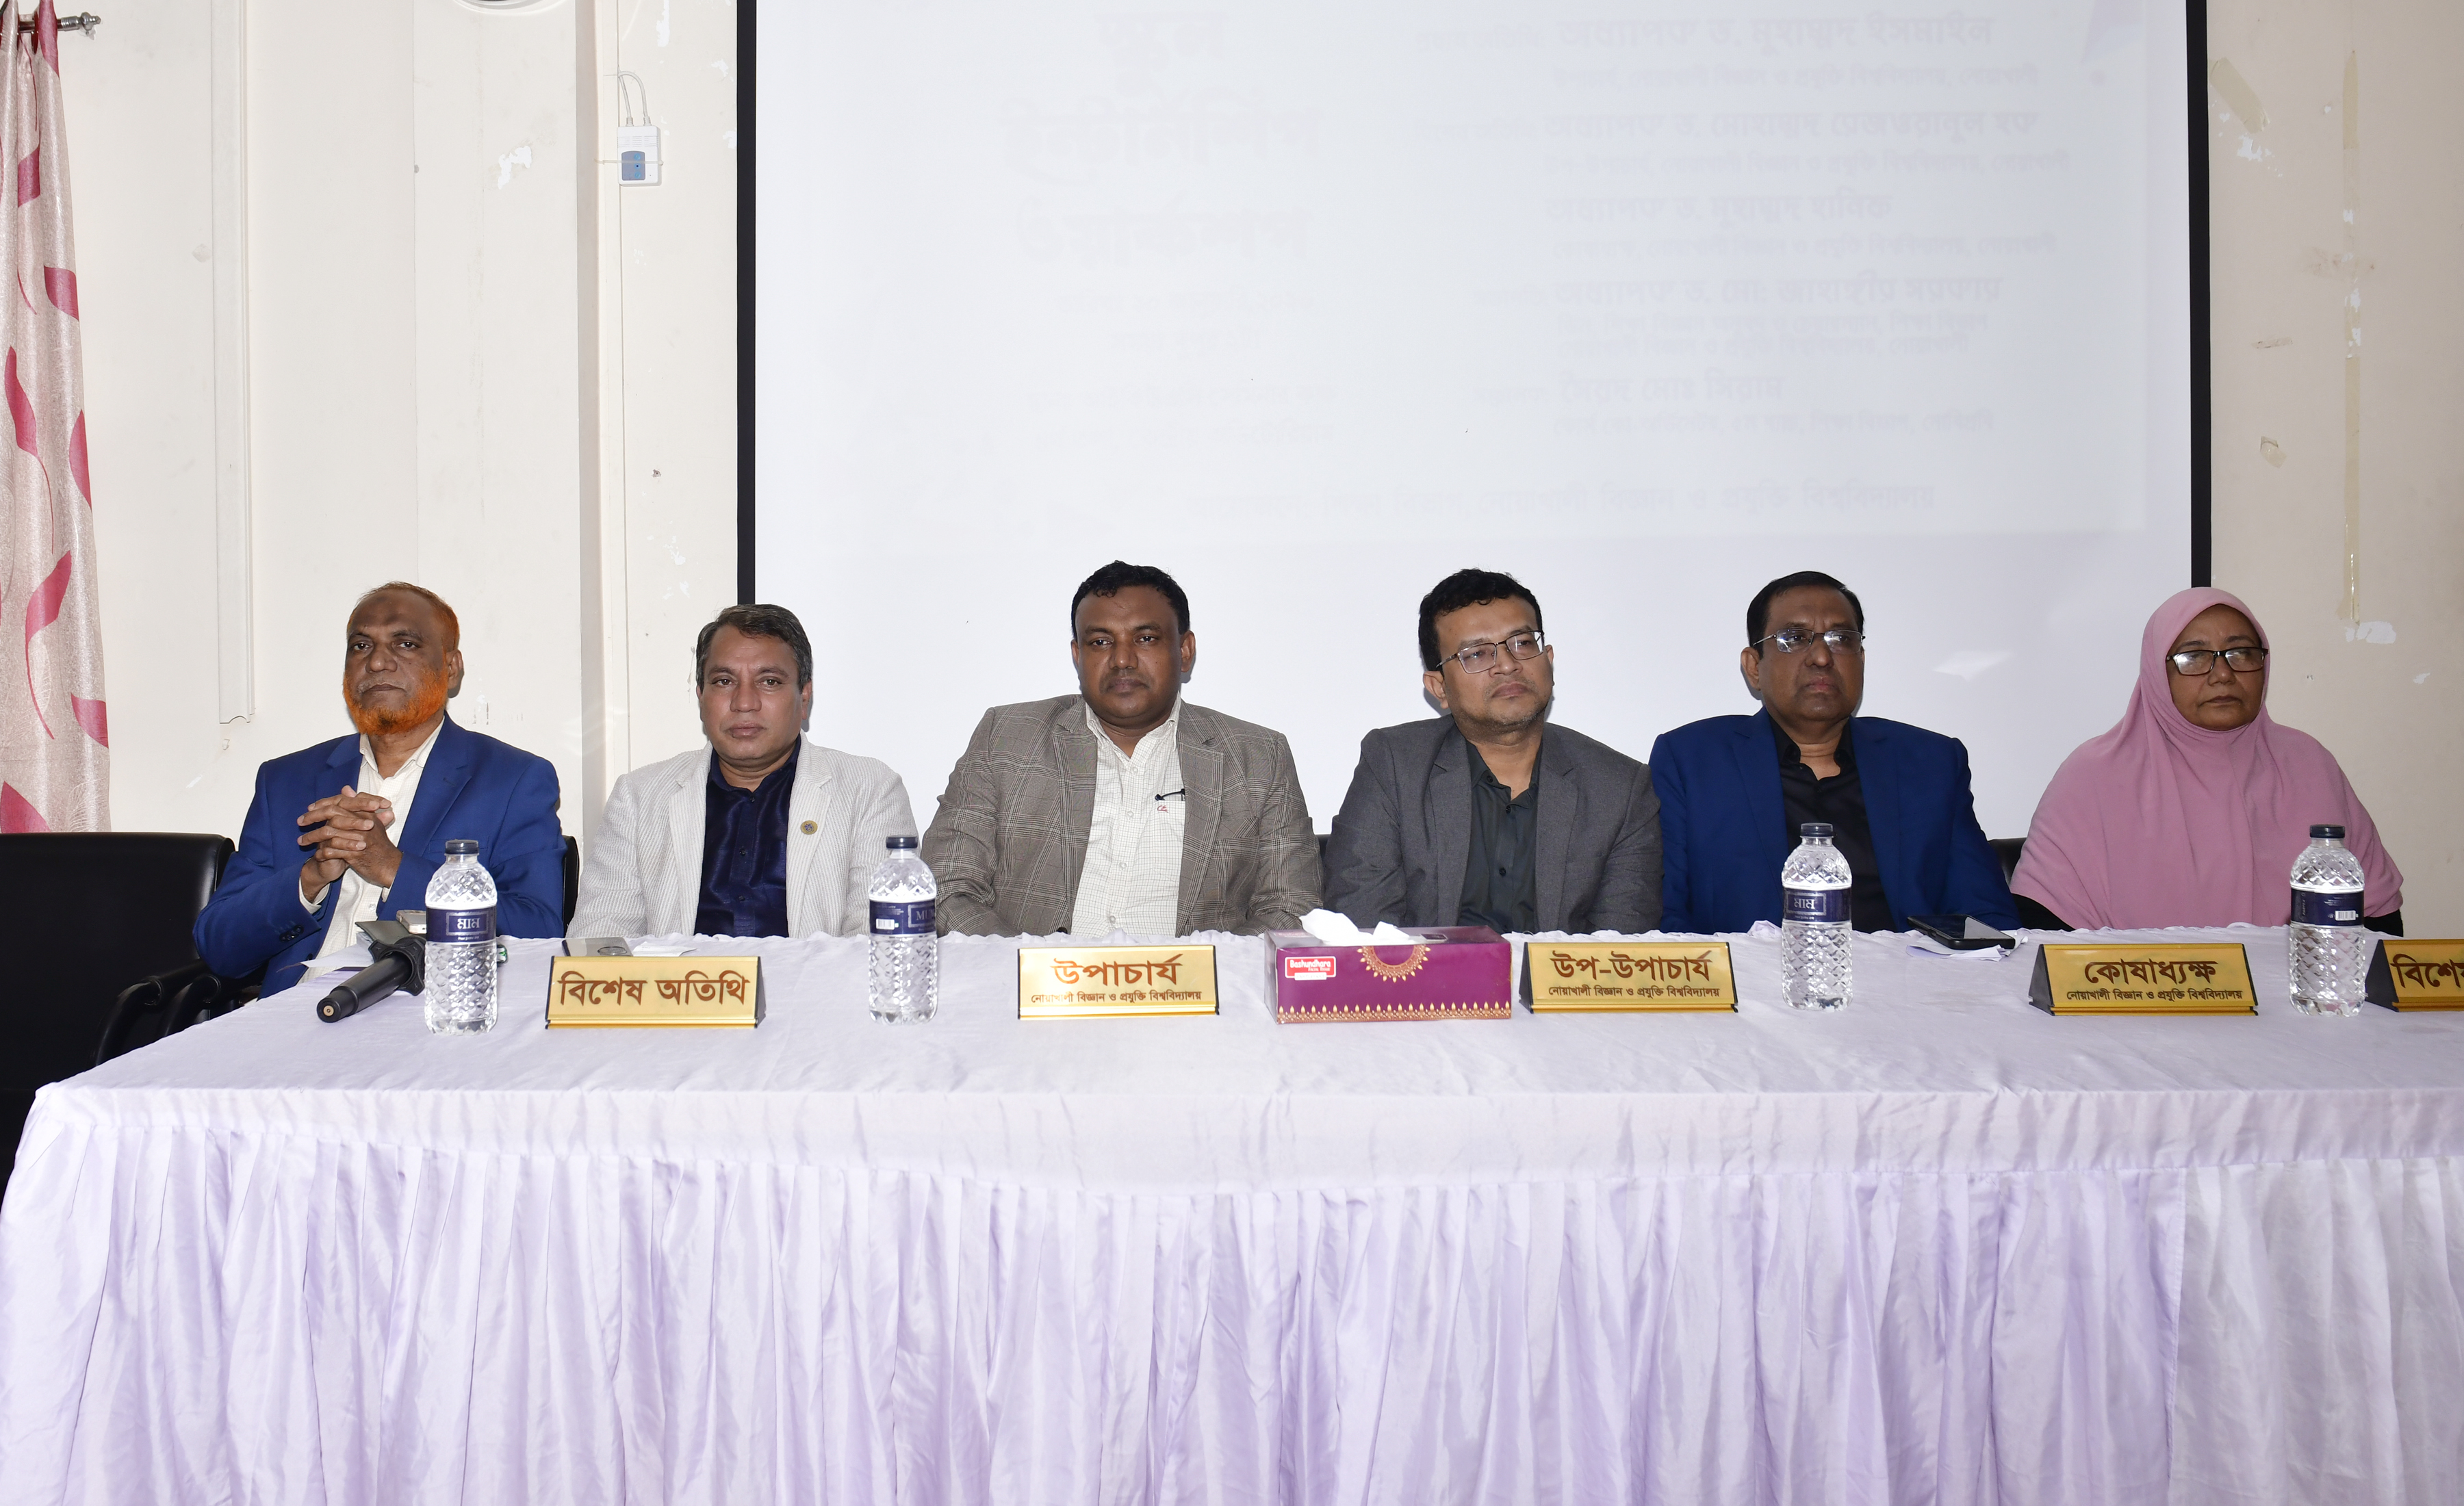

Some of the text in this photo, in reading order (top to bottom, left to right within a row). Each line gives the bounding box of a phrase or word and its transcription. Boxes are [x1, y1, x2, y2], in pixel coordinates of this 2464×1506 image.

[1556, 18, 1700, 48] অধ্যাপক
[1708, 18, 1742, 48] ড.
[1749, 18, 1859, 56] মুহাম্মদ
[1865, 9, 1996, 45] ইসমাইল
[1543, 113, 1667, 138] অধ্যাপক
[1671, 113, 1702, 138] ড.
[1710, 112, 1822, 139] মোহাম্মদ
[1992, 112, 2040, 135] হক
[1543, 196, 1669, 222] অধ্যাপক
[1673, 196, 1703, 221] ড.
[1709, 194, 1804, 229] মুহাম্মদ
[1553, 280, 1677, 306] অধ্যাপক
[1681, 279, 1711, 304] ড.
[1905, 276, 2004, 303] সরকার
[1558, 369, 1634, 406] সৈয়দ
[1600, 480, 1675, 512] বিজ্ঞান
[1687, 487, 1708, 510] ও
[1720, 479, 1791, 516] প্রযুক্তি
[1801, 479, 1936, 512] বিশ্ববিদ্যালয়
[1049, 953, 1184, 987] উপাচার্য
[1289, 959, 1331, 968] Bashundhara
[1550, 950, 1713, 982] উপ-উপাচার্য
[2084, 958, 2219, 985] কোষাধ্যক্ষ
[557, 970, 751, 1007] বিশেষ অতিথি
[1077, 990, 1105, 1003] বিজ্ঞান
[1109, 993, 1116, 1002] ও
[1119, 991, 1146, 1004] প্রযুক্তি
[1148, 989, 1203, 1002] বিশ্ববিদ্যালয়
[1548, 985, 1720, 999] নোয়াখালী বিজ্ঞান ও প্রযুক্তি বিশ্ববিদ্যালয়
[2066, 987, 2244, 1002] নোয়াখালী বিজ্ঞান ও প্রযুক্তি বিশ্ববিদ্যালয়
